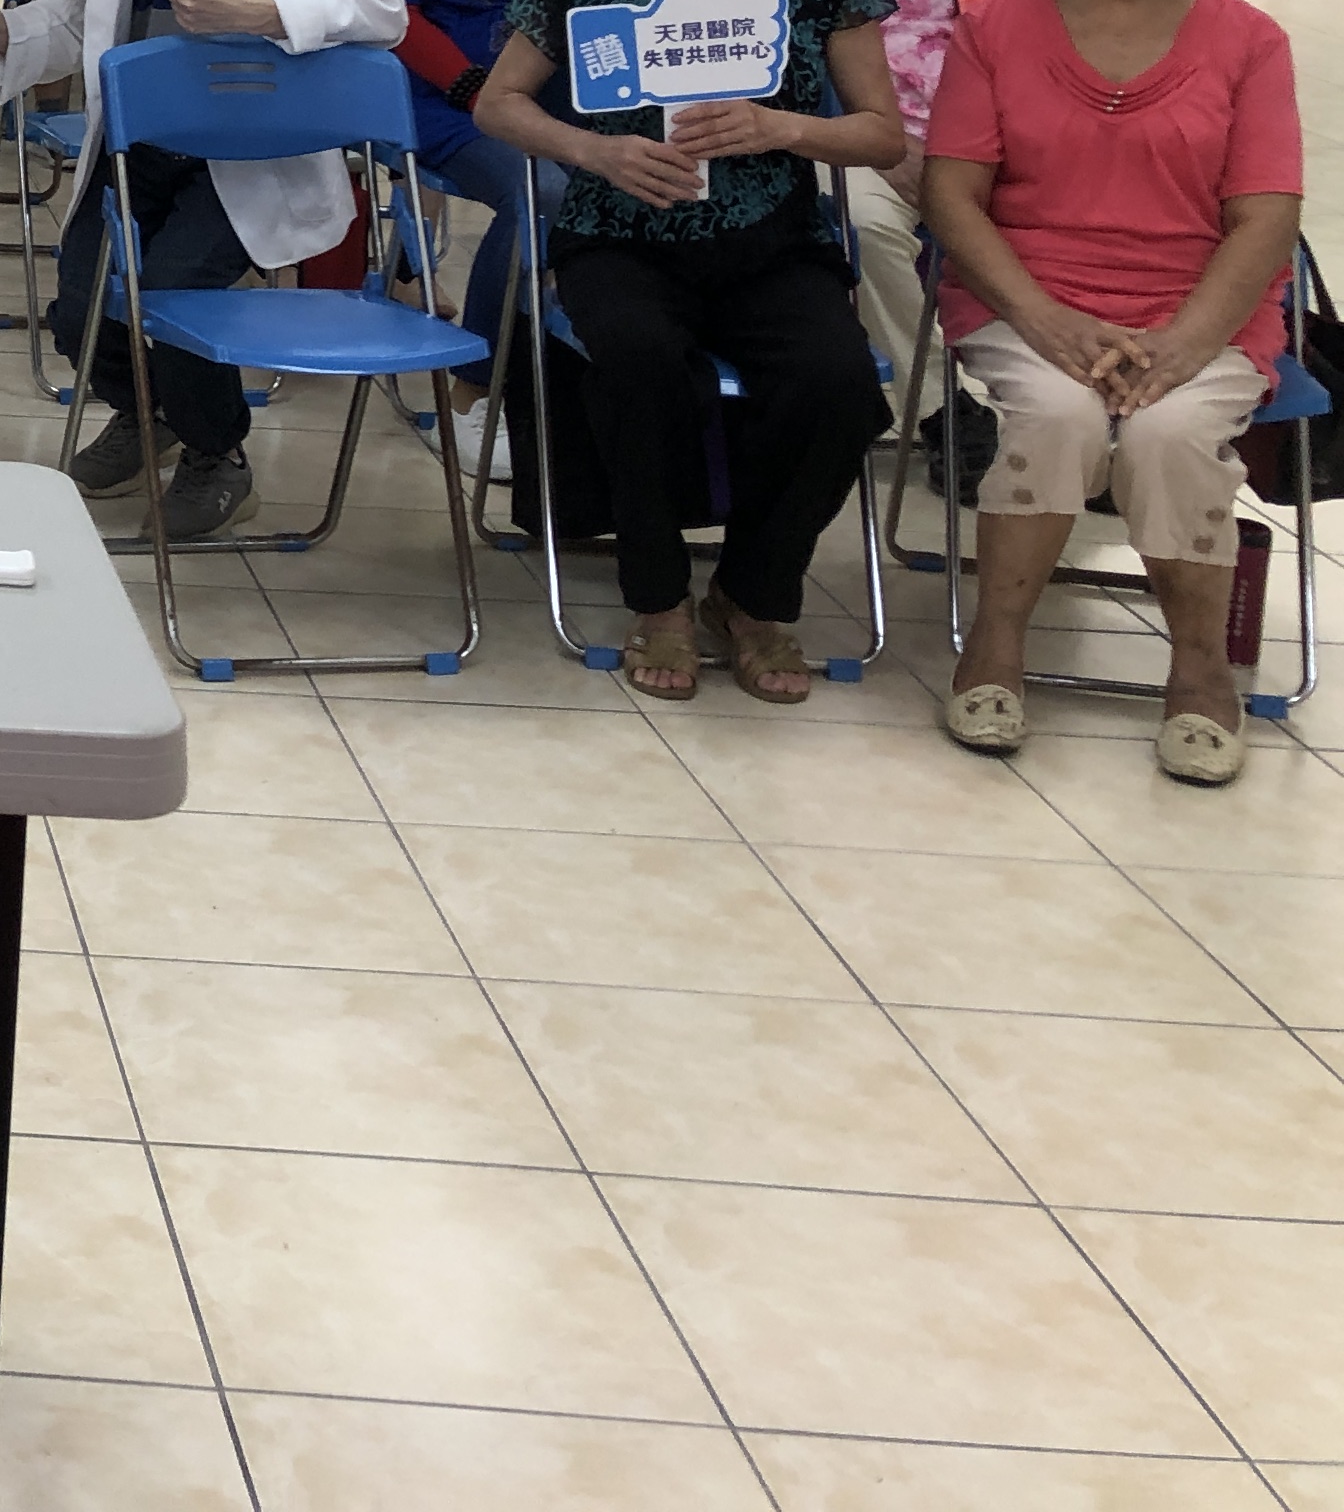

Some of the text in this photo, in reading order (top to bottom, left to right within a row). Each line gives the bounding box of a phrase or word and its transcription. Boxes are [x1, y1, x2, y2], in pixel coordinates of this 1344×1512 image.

[654, 17, 756, 45] 天晟醫院
[643, 40, 771, 69] 失智共照中心
